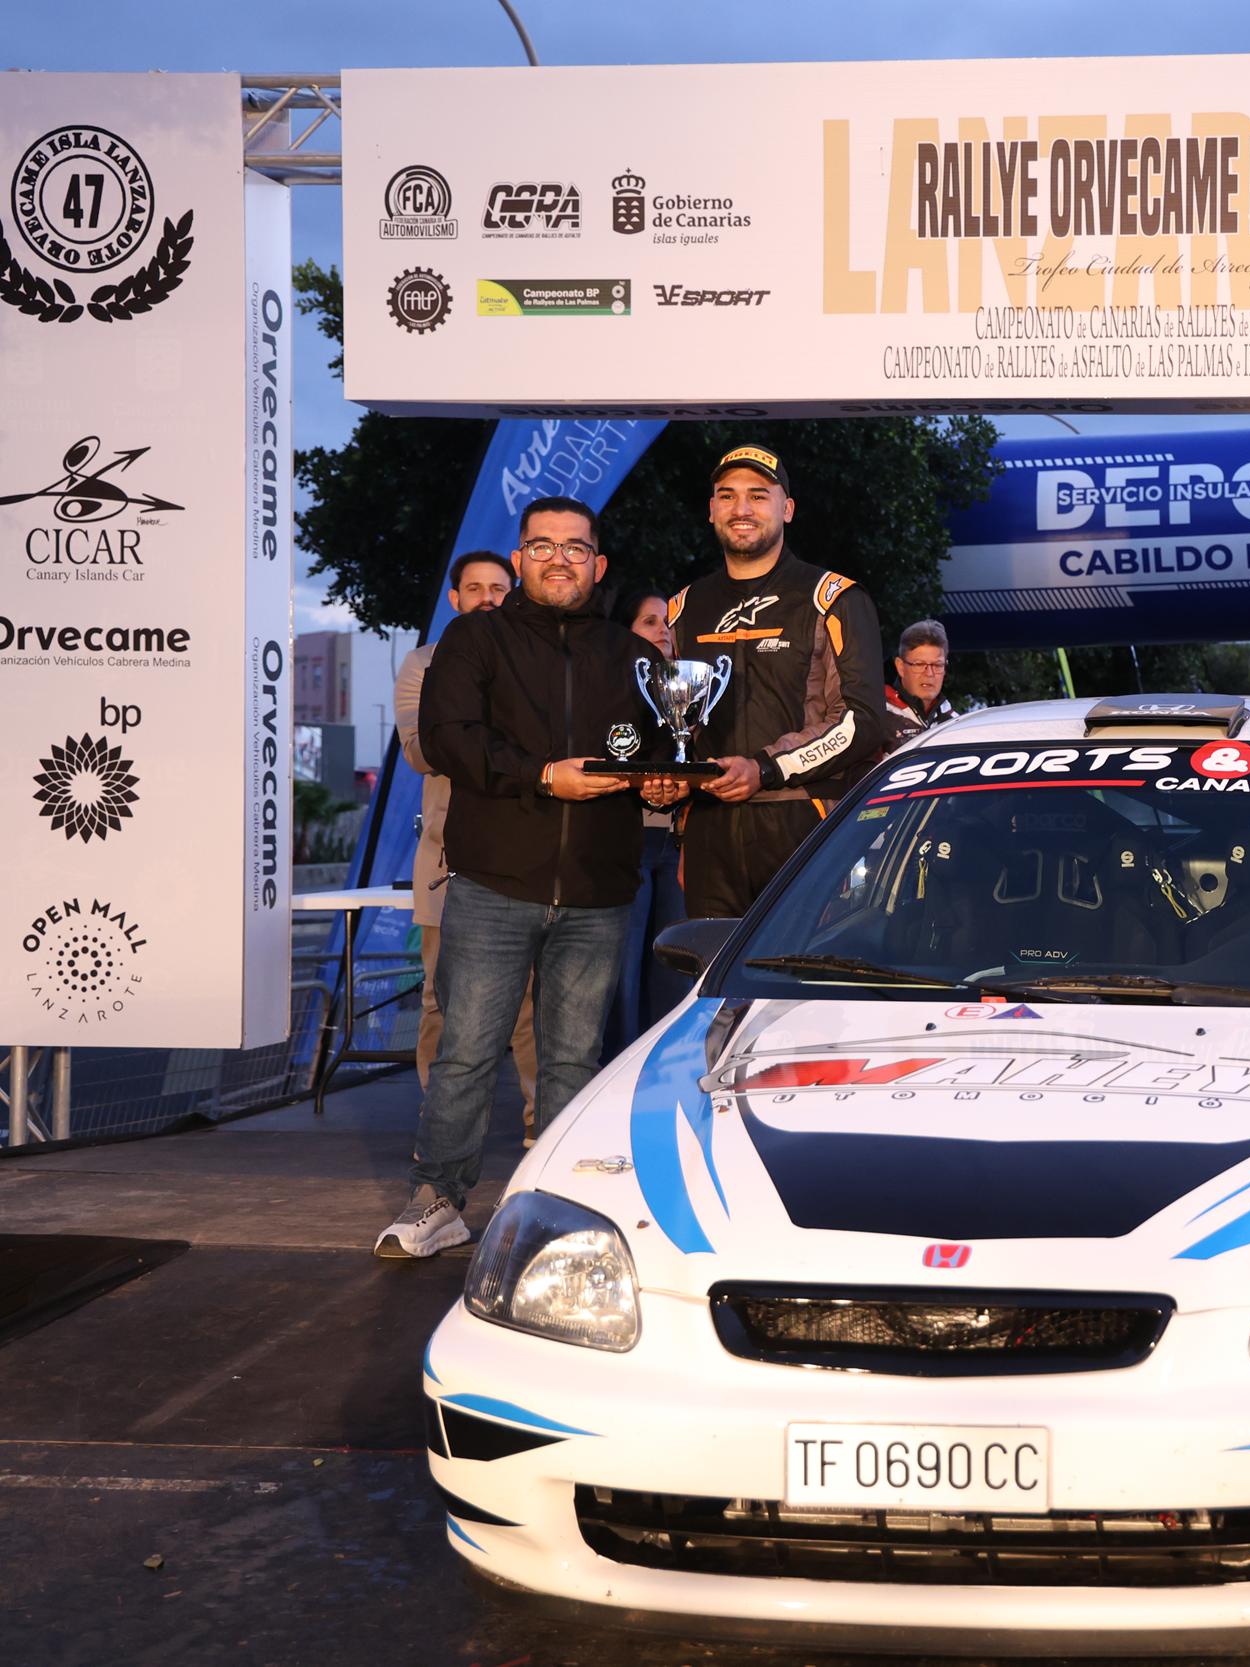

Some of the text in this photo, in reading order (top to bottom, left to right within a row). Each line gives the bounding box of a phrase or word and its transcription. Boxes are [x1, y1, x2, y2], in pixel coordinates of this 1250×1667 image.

[19, 132, 147, 265] ORVECAME ISLA LANZAROTE
[63, 174, 104, 228] 47
[402, 184, 435, 213] FCA
[653, 195, 733, 210] Gobierno
[917, 140, 1039, 238] RALLYE
[1050, 136, 1239, 237] ORVECAME
[384, 222, 454, 236] AUTOMOVILISMO
[652, 213, 751, 227] de Canarias
[653, 233, 719, 246] islas iguales
[1008, 250, 1078, 292] Trofeo
[1086, 254, 1156, 276] Ciudad
[1162, 254, 1184, 275] de
[523, 288, 600, 299] Campeonato BP
[976, 306, 1073, 339] CAMPEONATO
[1077, 314, 1086, 338] de
[1090, 305, 1161, 338] CANARIAS
[1164, 313, 1173, 338] de
[1177, 304, 1236, 338] RALLYES
[1239, 312, 1248, 337] de
[883, 345, 981, 379] CAMPEONATO
[984, 354, 994, 378] de
[997, 345, 1056, 378] RALLYES
[1058, 353, 1068, 377] de
[1071, 344, 1132, 378] ASFALTO
[1136, 353, 1145, 377] de
[1148, 344, 1174, 377] LAS
[1177, 343, 1233, 377] PALMAS
[262, 289, 283, 562] Orvecame
[1057, 485, 1163, 506] SERVICIO
[26, 528, 143, 564] CICAR
[1059, 545, 1240, 577] CABILDO
[26, 568, 145, 583] Canary Islands Car
[1, 655, 191, 668] anización Vehículos Cabrera Medina
[101, 697, 142, 734] bp
[799, 732, 847, 767] ASTARS
[262, 640, 283, 910] Orvecame
[880, 747, 1178, 791] SPORTS
[1202, 747, 1249, 773] &
[23, 898, 147, 954] OPEN MALL
[1020, 949, 1068, 960] PRO ADV
[26, 973, 142, 1024] LANZAROTE
[795, 1439, 1038, 1491] TF 0690 CC
